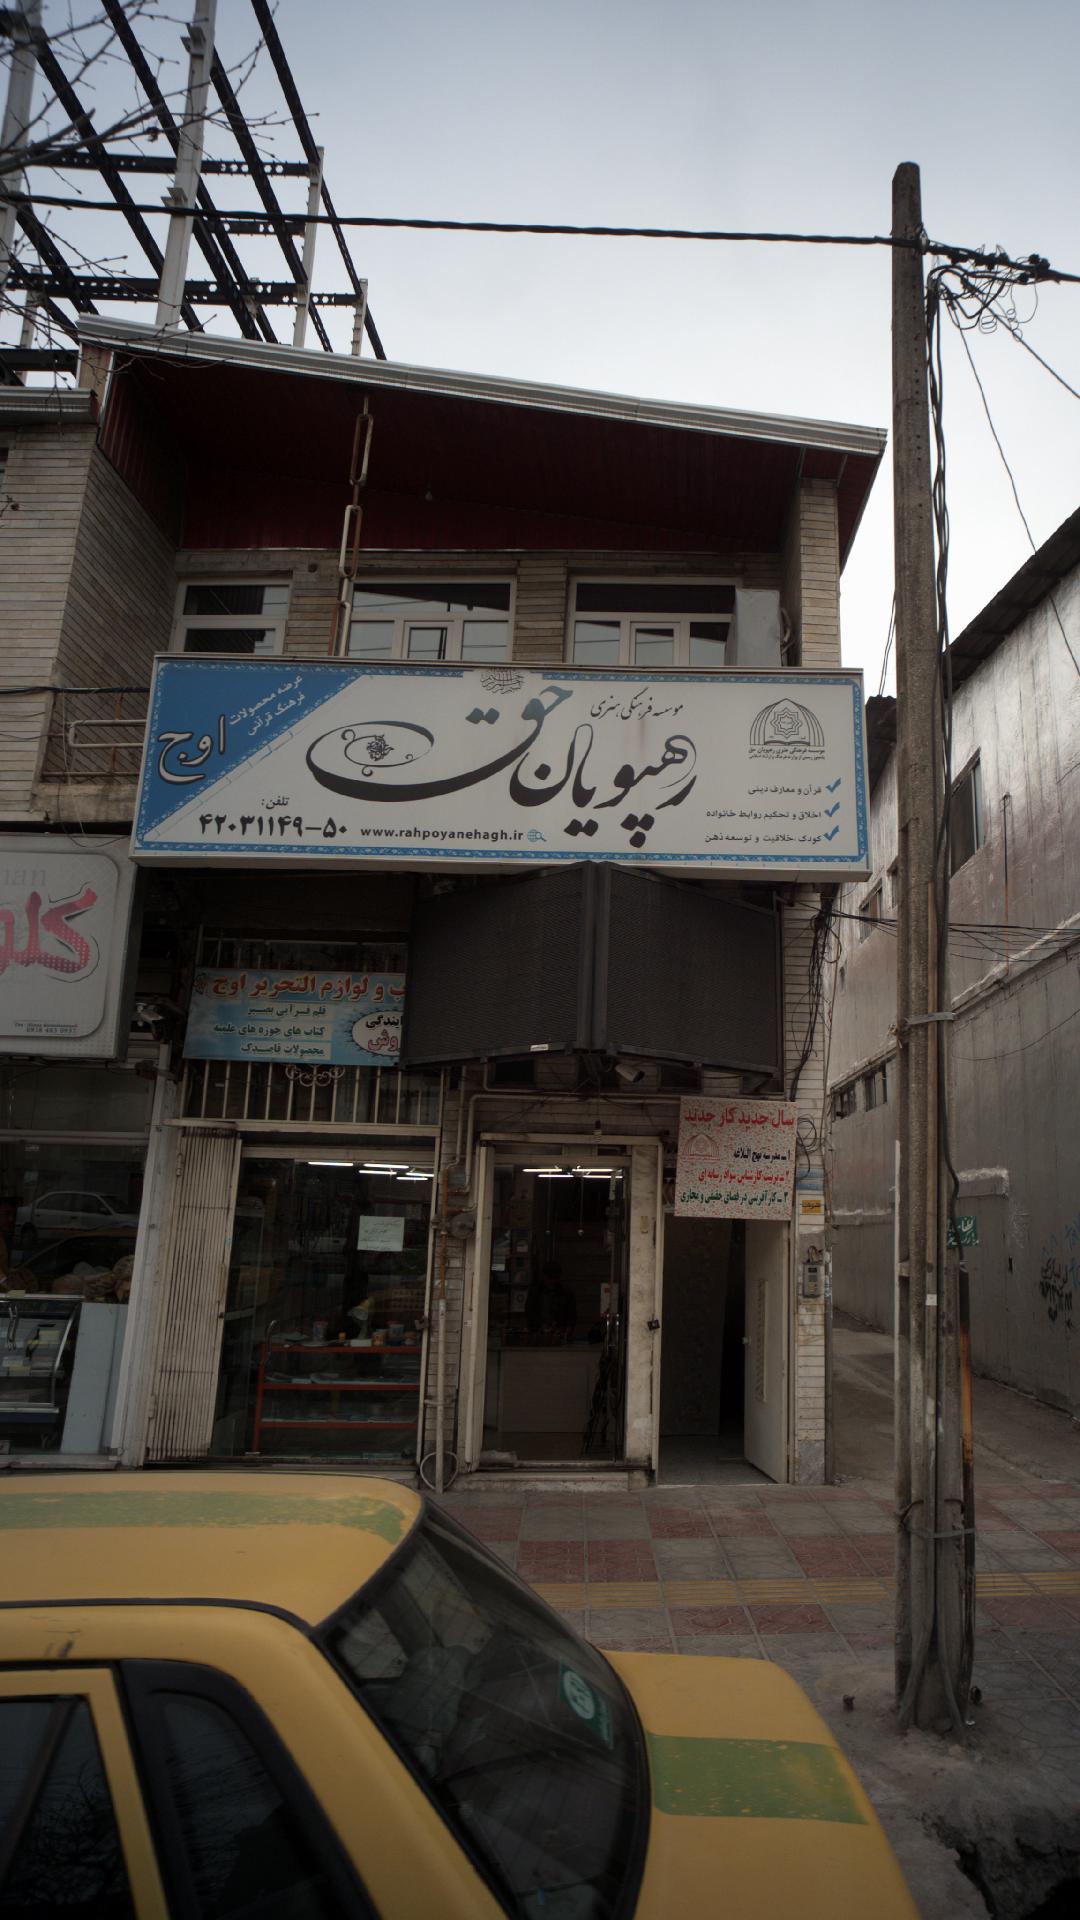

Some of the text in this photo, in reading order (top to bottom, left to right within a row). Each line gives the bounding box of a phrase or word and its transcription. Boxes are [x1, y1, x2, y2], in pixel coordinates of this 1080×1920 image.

[229, 692, 277, 725] محصولات
[652, 703, 684, 717] موسسه
[158, 714, 226, 784] اوج
[306, 685, 697, 848] رهپویان حق
[748, 785, 768, 795] دینی
[769, 785, 795, 795] معارف
[803, 784, 822, 796] قرآن
[706, 809, 737, 819] خانواده
[738, 810, 762, 820] روابط
[764, 810, 789, 821] تحکیم
[798, 810, 821, 821] اخلاق
[360, 827, 524, 842] www.rahpoyanehagh.ir
[725, 833, 752, 844] توسعه
[213, 971, 248, 999] اوج
[248, 973, 316, 999] التحریر
[319, 974, 369, 1002] لوازم
[372, 984, 385, 1002] و
[304, 1025, 326, 1037] کتاب
[718, 1106, 738, 1128] کار
[738, 1109, 769, 1130] جدید
[771, 1107, 795, 1129] سال
